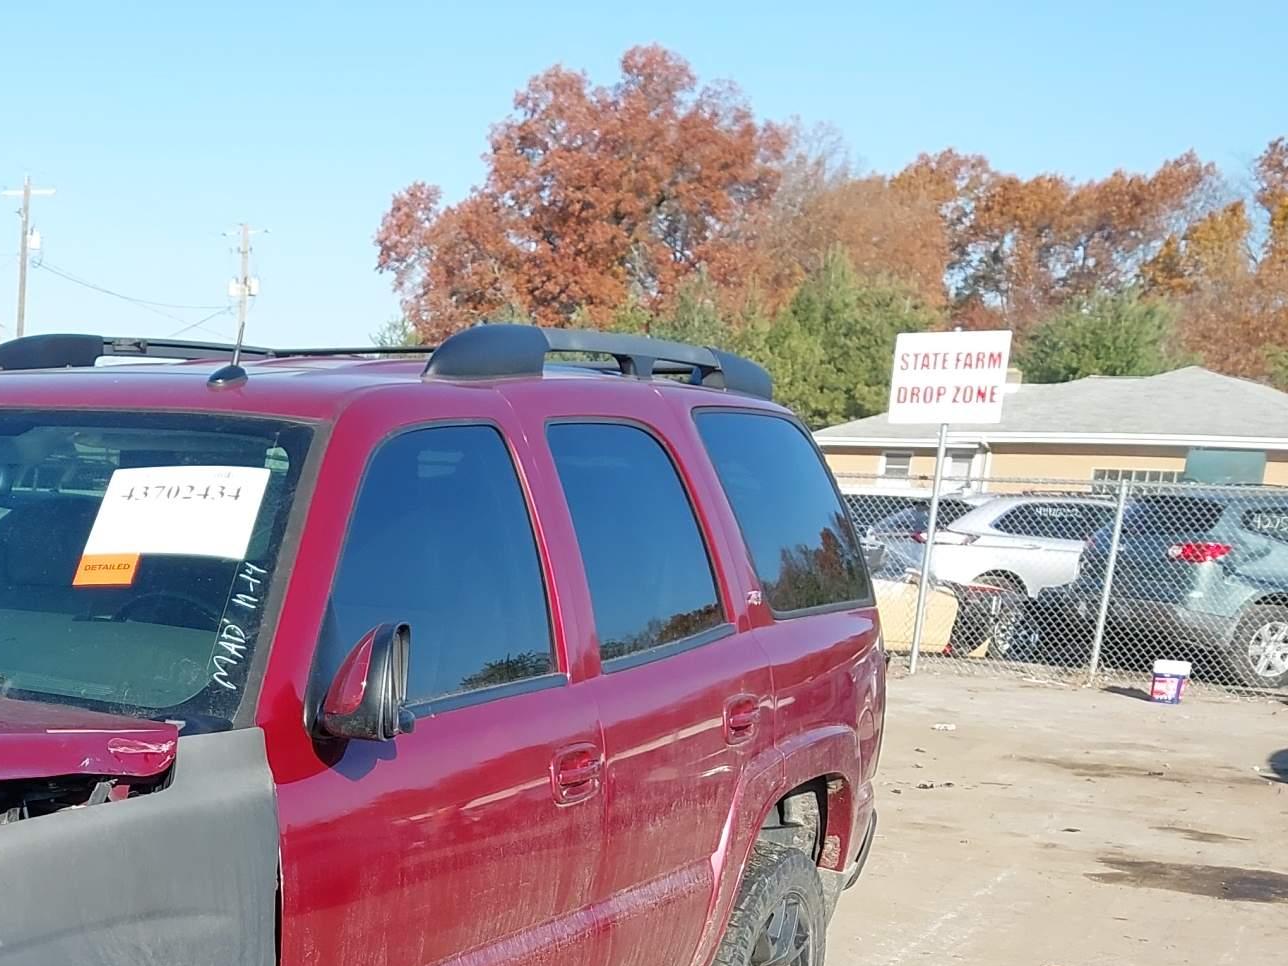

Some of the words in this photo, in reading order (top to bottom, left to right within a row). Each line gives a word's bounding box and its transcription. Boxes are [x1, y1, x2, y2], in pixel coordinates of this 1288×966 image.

[900, 352, 949, 371] STATE
[954, 351, 1003, 370] FARM
[896, 386, 947, 404] DROP
[951, 385, 999, 404] ZONE
[121, 485, 243, 501] 43702434
[84, 563, 131, 572] DETAILED
